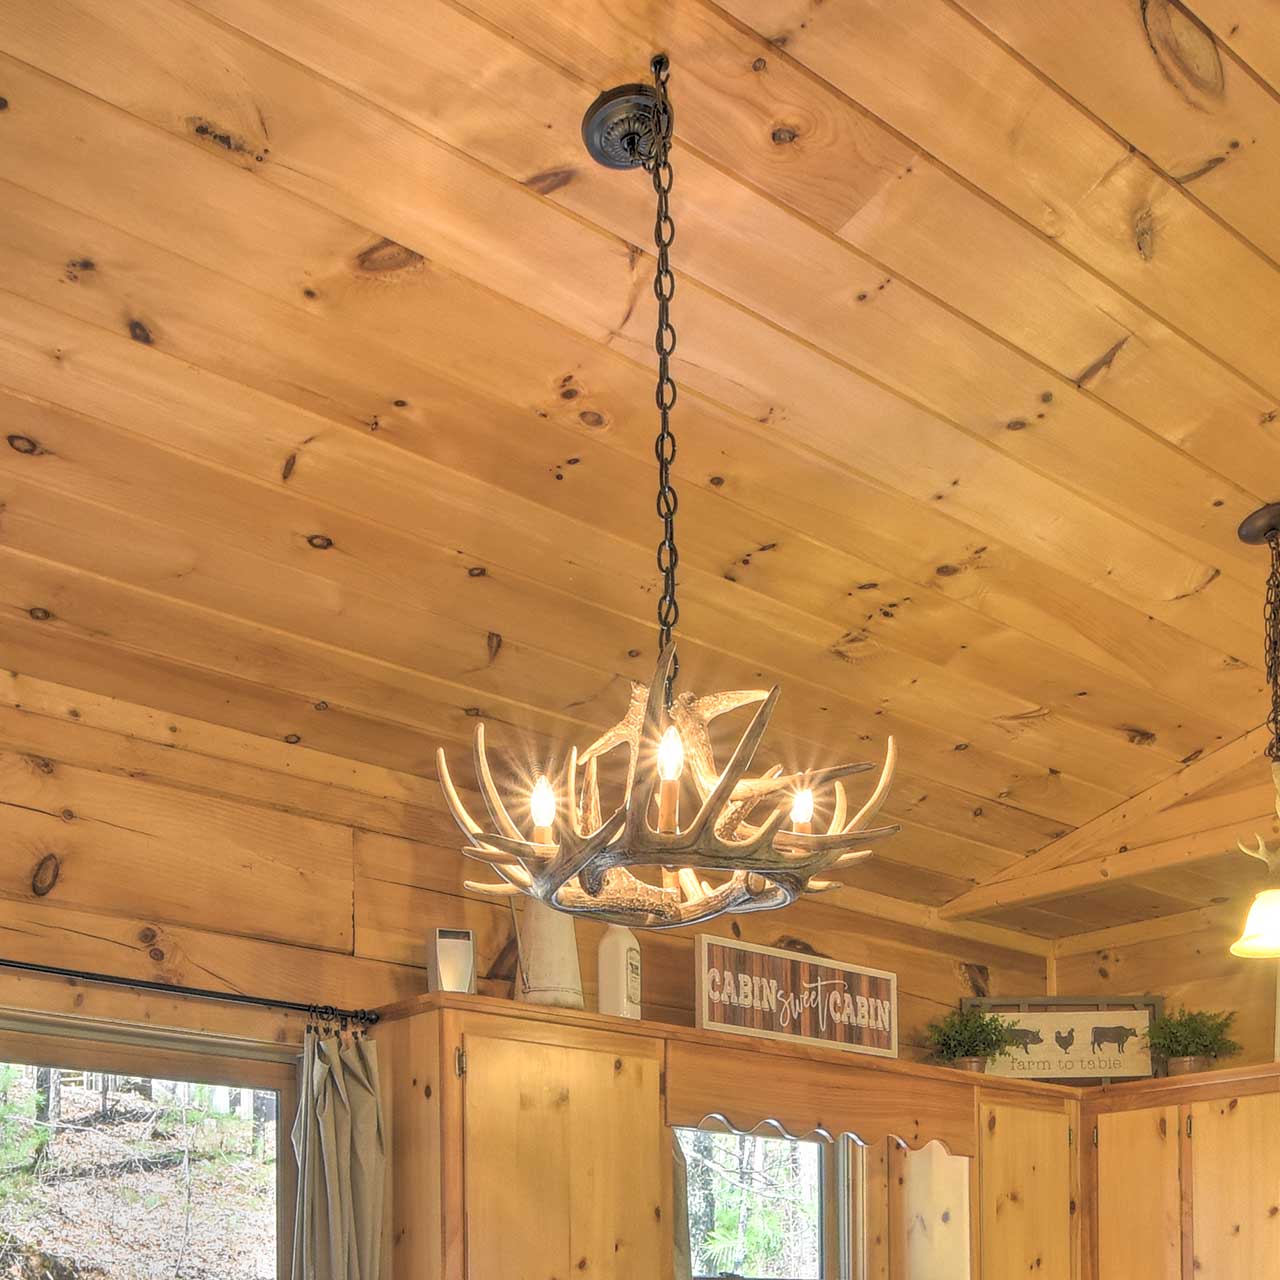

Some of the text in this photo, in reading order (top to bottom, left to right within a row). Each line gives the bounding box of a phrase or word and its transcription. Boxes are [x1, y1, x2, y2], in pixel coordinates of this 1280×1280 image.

[708, 968, 890, 1031] CABIN sweet CABIN
[1010, 1056, 1122, 1071] farm to table
